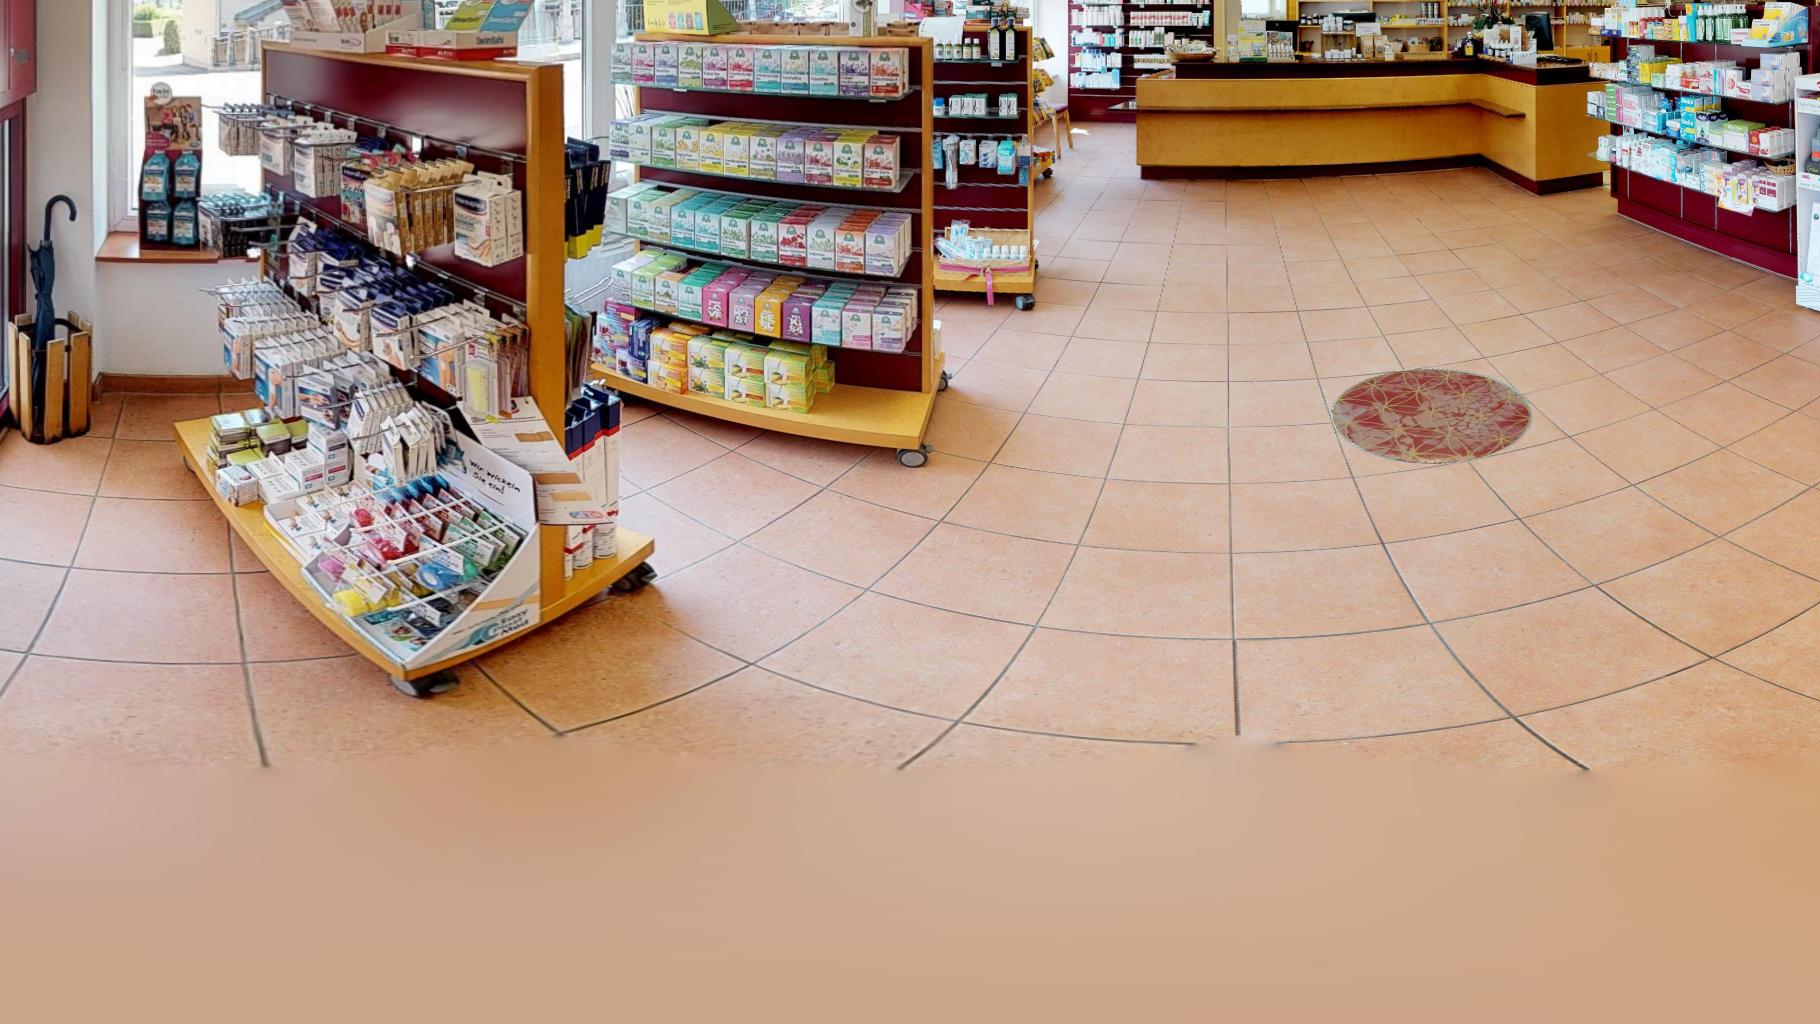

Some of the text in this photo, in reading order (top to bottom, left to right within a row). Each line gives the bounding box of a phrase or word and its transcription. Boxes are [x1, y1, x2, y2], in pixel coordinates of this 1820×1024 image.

[469, 459, 521, 493] Wir wickeln
[473, 472, 505, 495] Sie ein!
